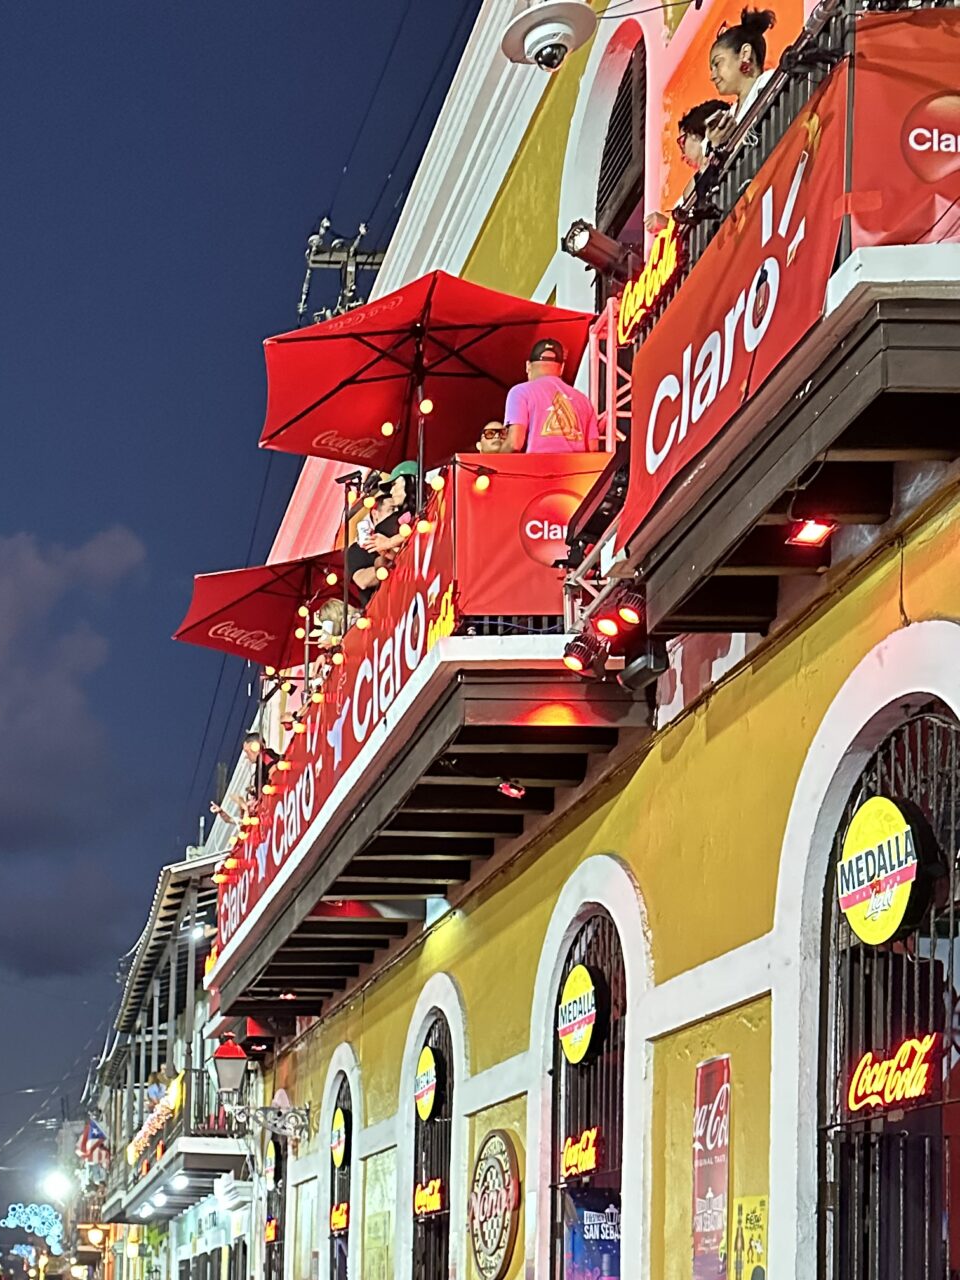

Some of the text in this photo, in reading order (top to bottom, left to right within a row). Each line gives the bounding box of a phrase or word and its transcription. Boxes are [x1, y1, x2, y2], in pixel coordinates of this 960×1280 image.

[840, 829, 917, 895] MEDALLA
[559, 990, 596, 1027] MEDALLA
[848, 1032, 937, 1112] Coca-Cola
[583, 1224, 600, 1240] SAN
